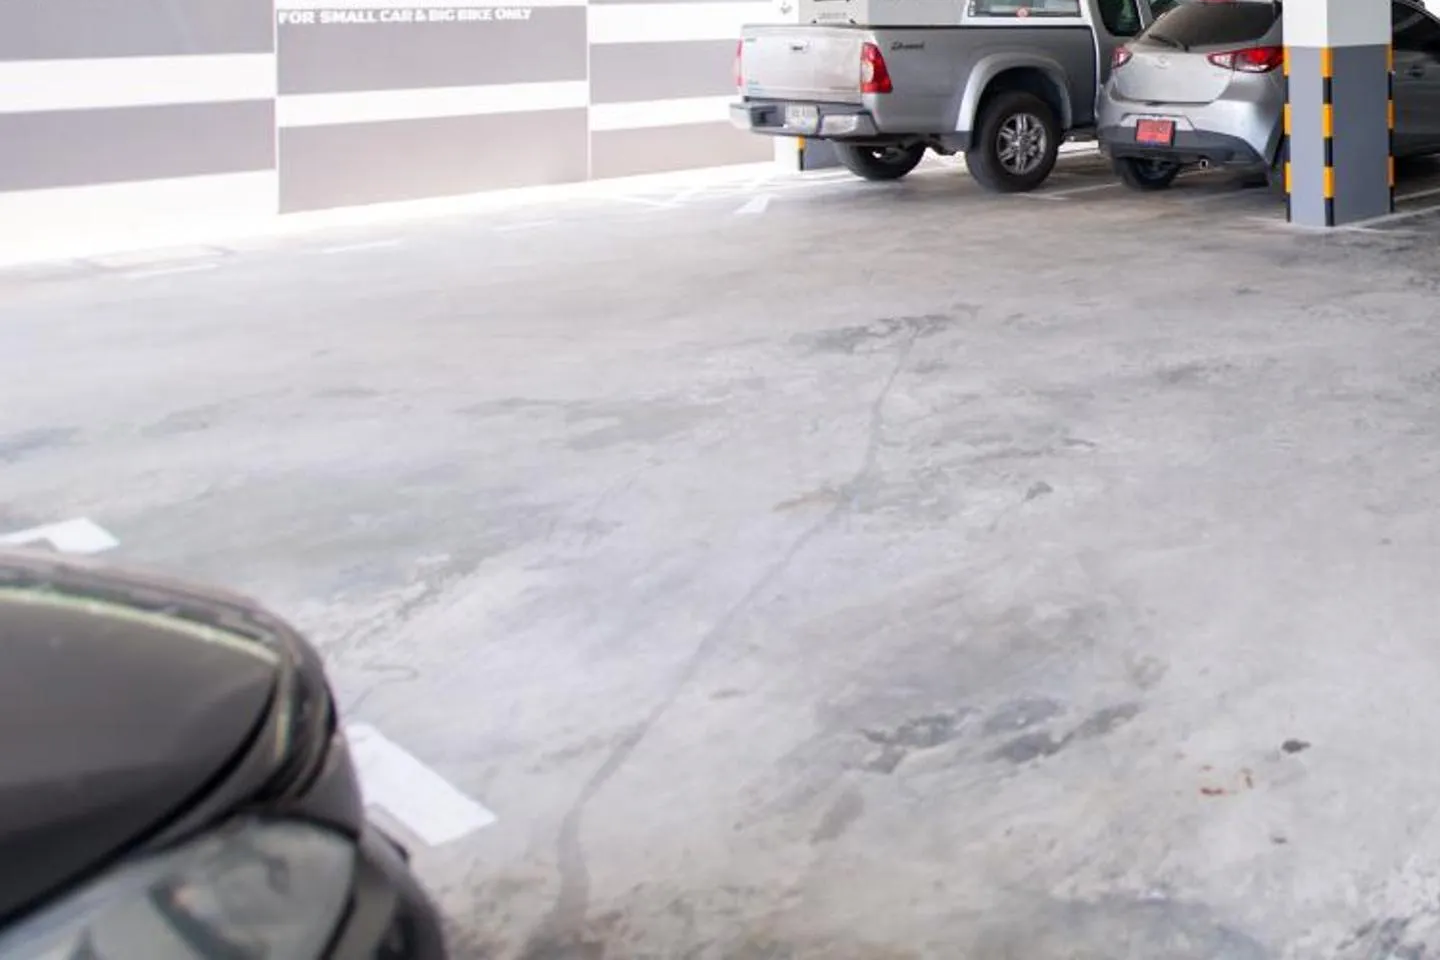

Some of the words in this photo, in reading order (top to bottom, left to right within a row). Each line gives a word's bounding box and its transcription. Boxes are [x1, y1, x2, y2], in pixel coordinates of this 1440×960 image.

[279, 10, 315, 24] FOR
[319, 9, 378, 23] SMALL
[380, 8, 413, 22] CAR
[429, 8, 456, 21] BIG
[457, 7, 493, 21] BIKE
[494, 7, 532, 20] ONLY
